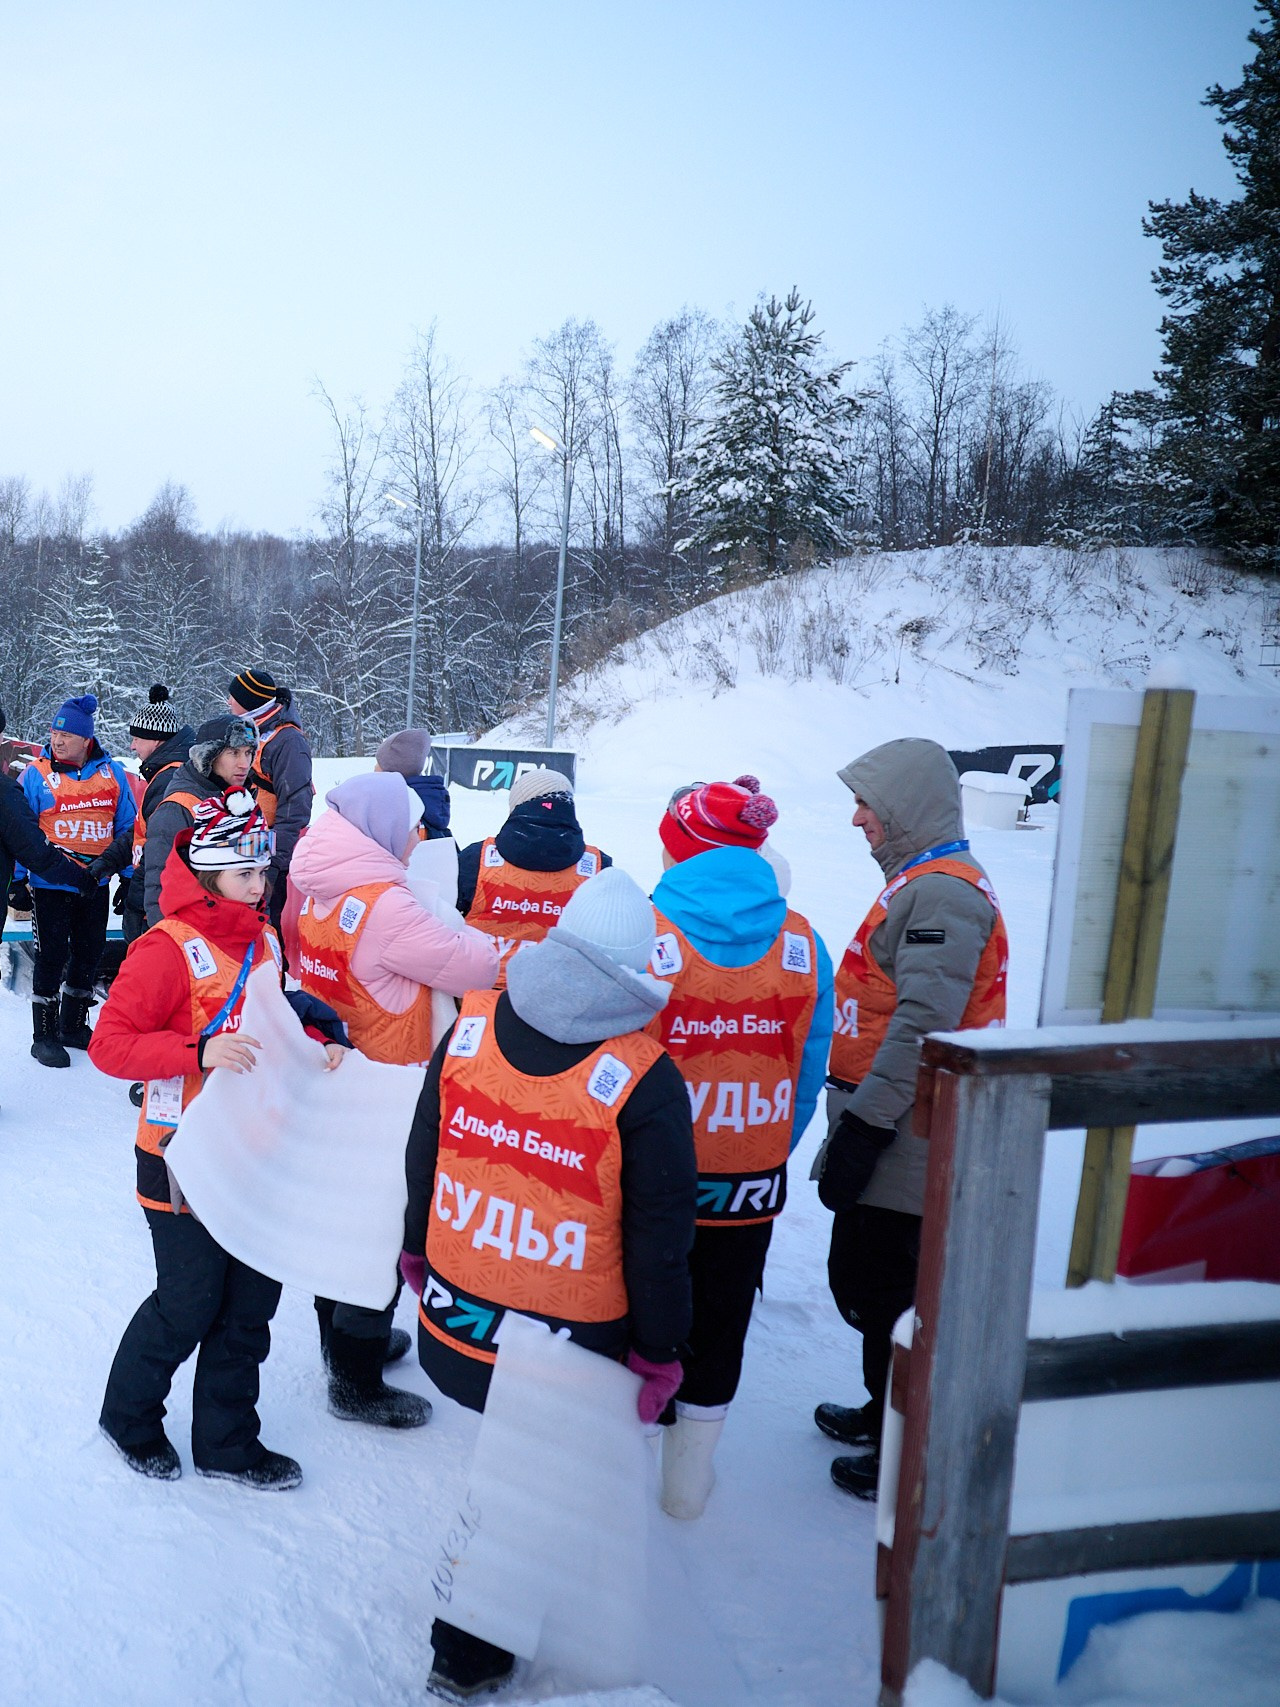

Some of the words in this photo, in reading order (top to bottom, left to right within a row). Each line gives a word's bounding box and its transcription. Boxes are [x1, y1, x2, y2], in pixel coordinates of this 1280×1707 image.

[492, 896, 540, 915] Альфа
[542, 901, 564, 916] Ба
[669, 1015, 739, 1043] Альфа
[685, 1079, 793, 1134] УДЬЯ
[448, 1105, 520, 1149] Альфа
[522, 1129, 586, 1172] Банк
[696, 1174, 781, 1214] ARI
[435, 1171, 588, 1271] СУДЬЯ
